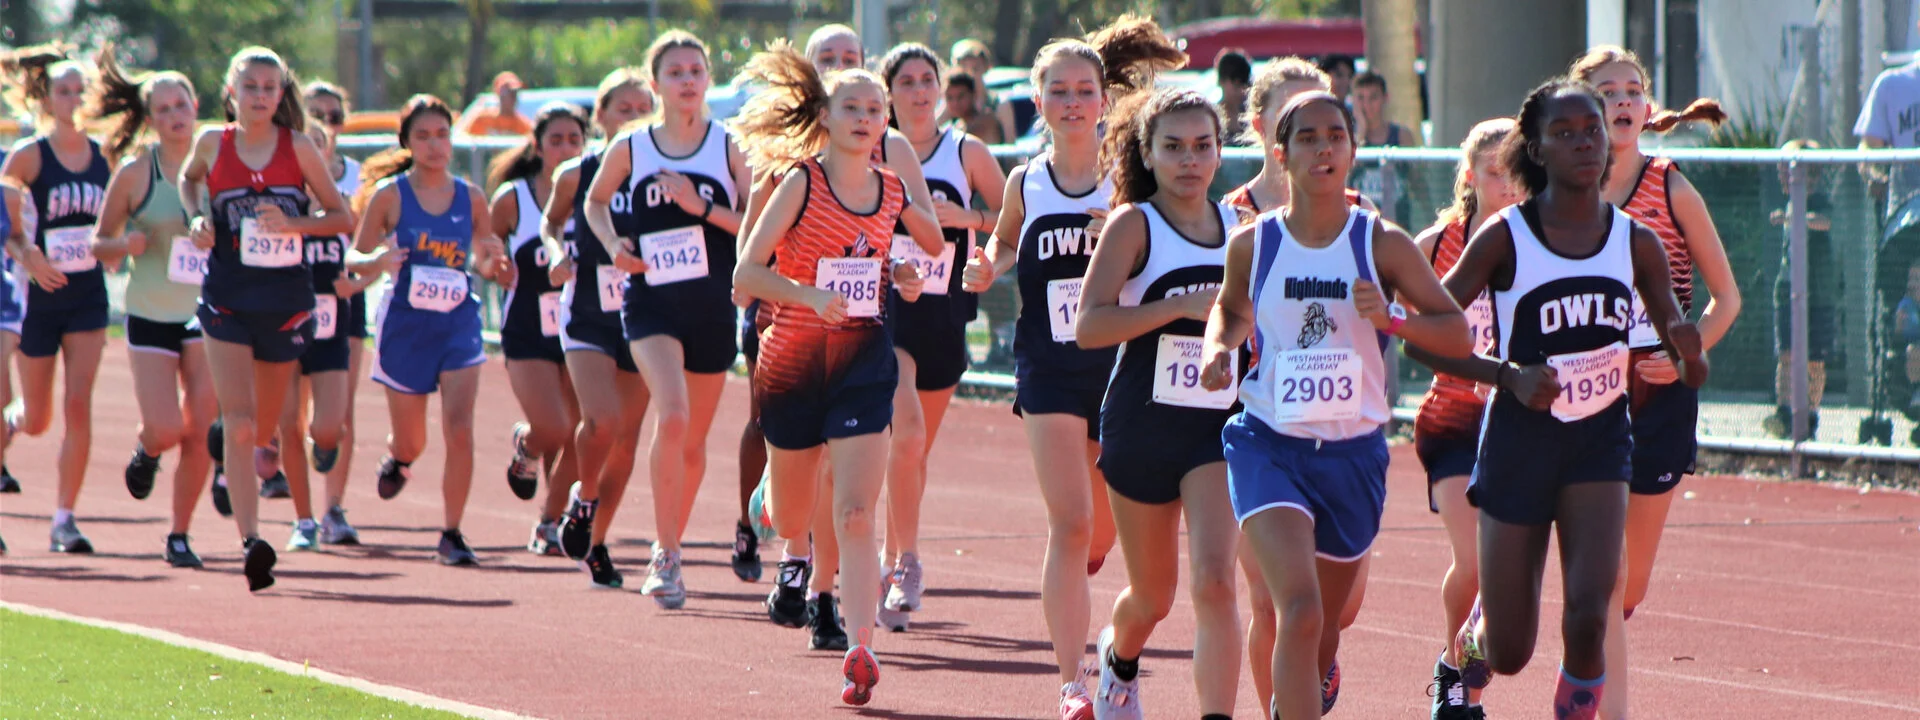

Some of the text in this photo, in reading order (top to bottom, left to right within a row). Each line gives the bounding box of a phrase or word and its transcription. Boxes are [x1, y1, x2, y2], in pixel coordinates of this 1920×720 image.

[248, 236, 296, 254] 2974
[651, 245, 702, 270] 1942
[830, 262, 874, 270] WESTMINSTER
[837, 269, 869, 277] ACADEMY
[416, 280, 462, 301] 2916
[825, 280, 876, 301] 1985
[1285, 276, 1349, 300] Highlands
[1540, 293, 1628, 334] OWLS
[1287, 353, 1348, 363] WESTMINSTER
[1295, 362, 1338, 371] ACADEMY
[1562, 348, 1618, 367] WESTMINSTER
[1573, 360, 1612, 375] ACADEMY
[1282, 376, 1353, 403] 2903
[1561, 367, 1620, 404] 1930
